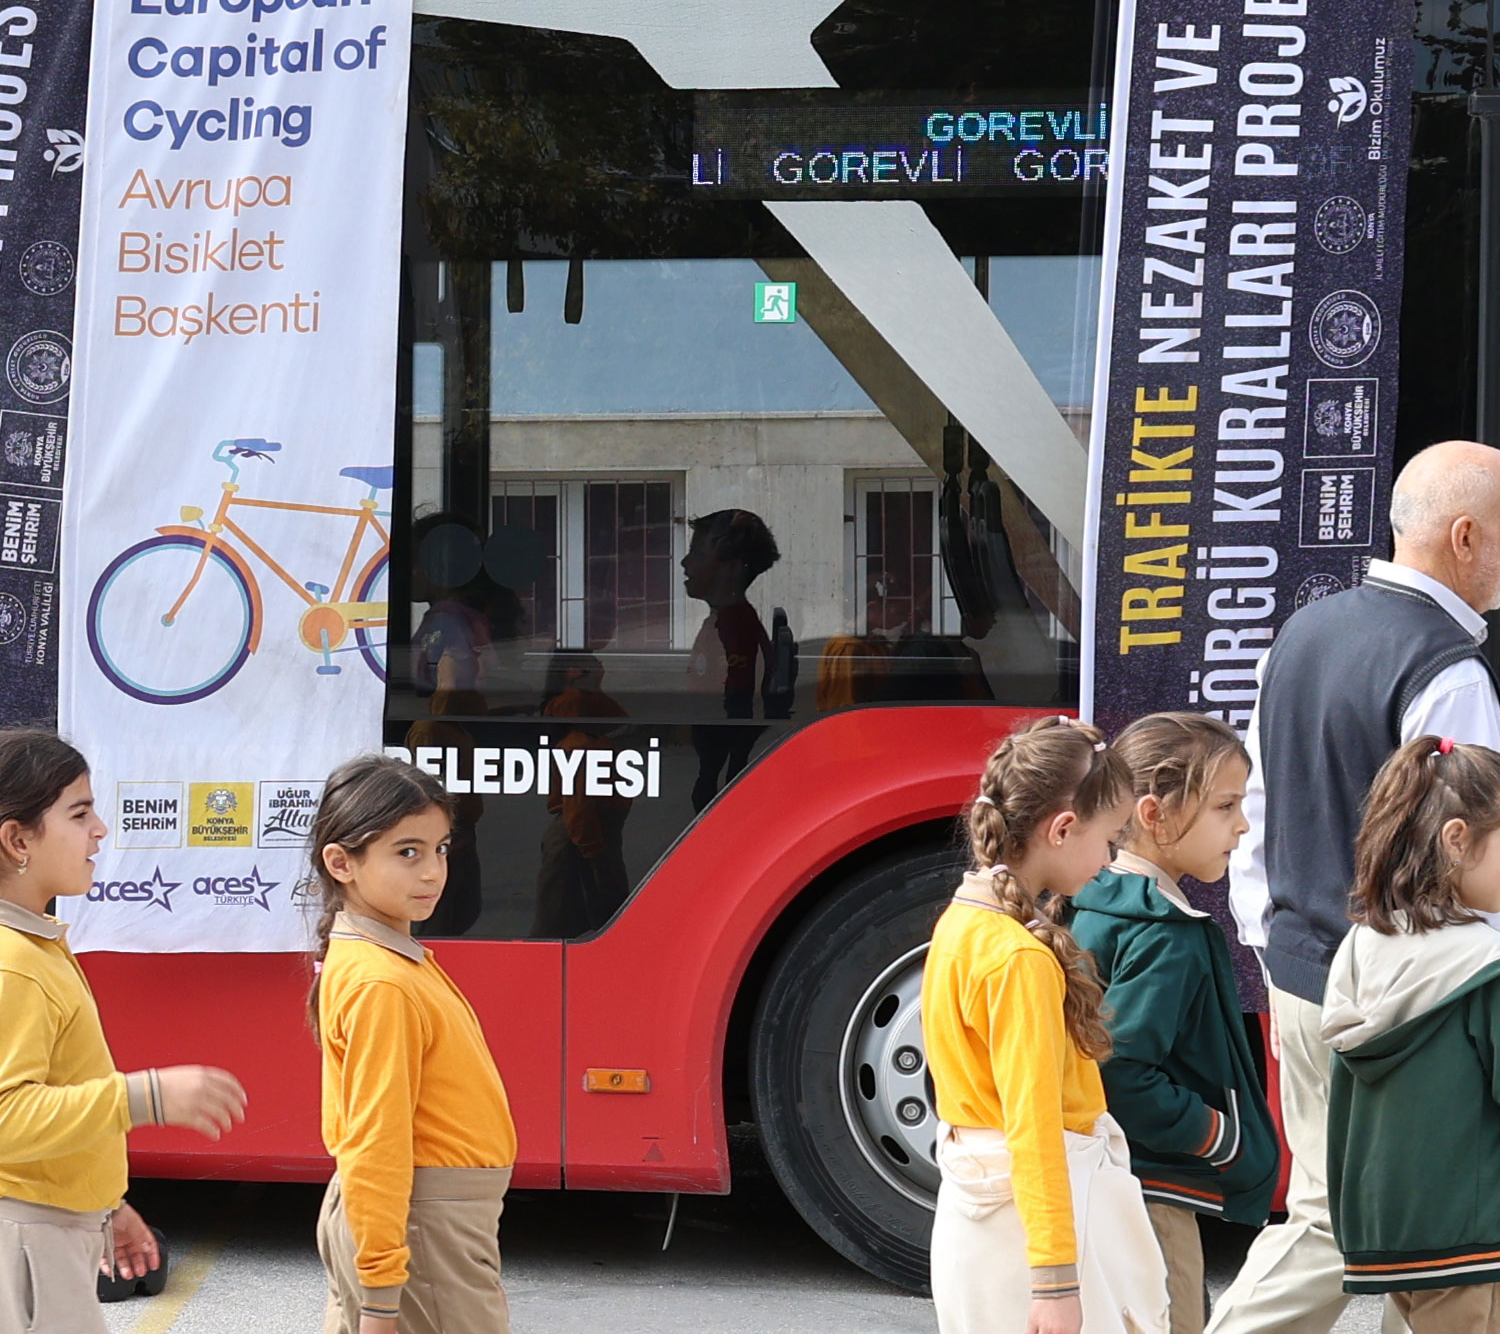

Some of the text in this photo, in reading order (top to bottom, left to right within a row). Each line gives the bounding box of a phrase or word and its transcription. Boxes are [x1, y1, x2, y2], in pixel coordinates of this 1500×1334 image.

[127, 25, 386, 87] Capital of
[1368, 37, 1386, 160] Bizim Okulumuz
[123, 98, 312, 152] Cycling
[927, 102, 1106, 142] GOREVLİ
[773, 145, 962, 184] GOREVLİ
[119, 169, 291, 212] Avrupa
[1367, 213, 1375, 239] KONYA
[119, 230, 284, 274] Bisiklet
[114, 292, 319, 346] Başkenti
[1119, 23, 1222, 655] TRAFİKTE NEZAKET VE
[1214, 195, 1296, 522] KURALLARI
[1344, 401, 1352, 434] KONYA
[1352, 385, 1364, 451] BÜYÜKŞEHİR
[34, 436, 44, 466] KONYA
[41, 422, 58, 483] BÜYÜKŞEHİR
[1319, 475, 1337, 540] BENİM
[1337, 474, 1354, 539] ŞEHRİM
[1, 501, 24, 562] BENİM
[21, 504, 41, 564] ŞEHRİM
[36, 582, 54, 665] KONYA VALİLİĞİ
[123, 799, 177, 814] BENİM
[277, 787, 310, 799] UĞUR
[122, 818, 176, 832] ŞEHRİM
[192, 824, 248, 836] BÜYÜKŞEHİR
[207, 817, 234, 825] KONYA
[86, 881, 153, 902] aces
[193, 876, 255, 895] aces
